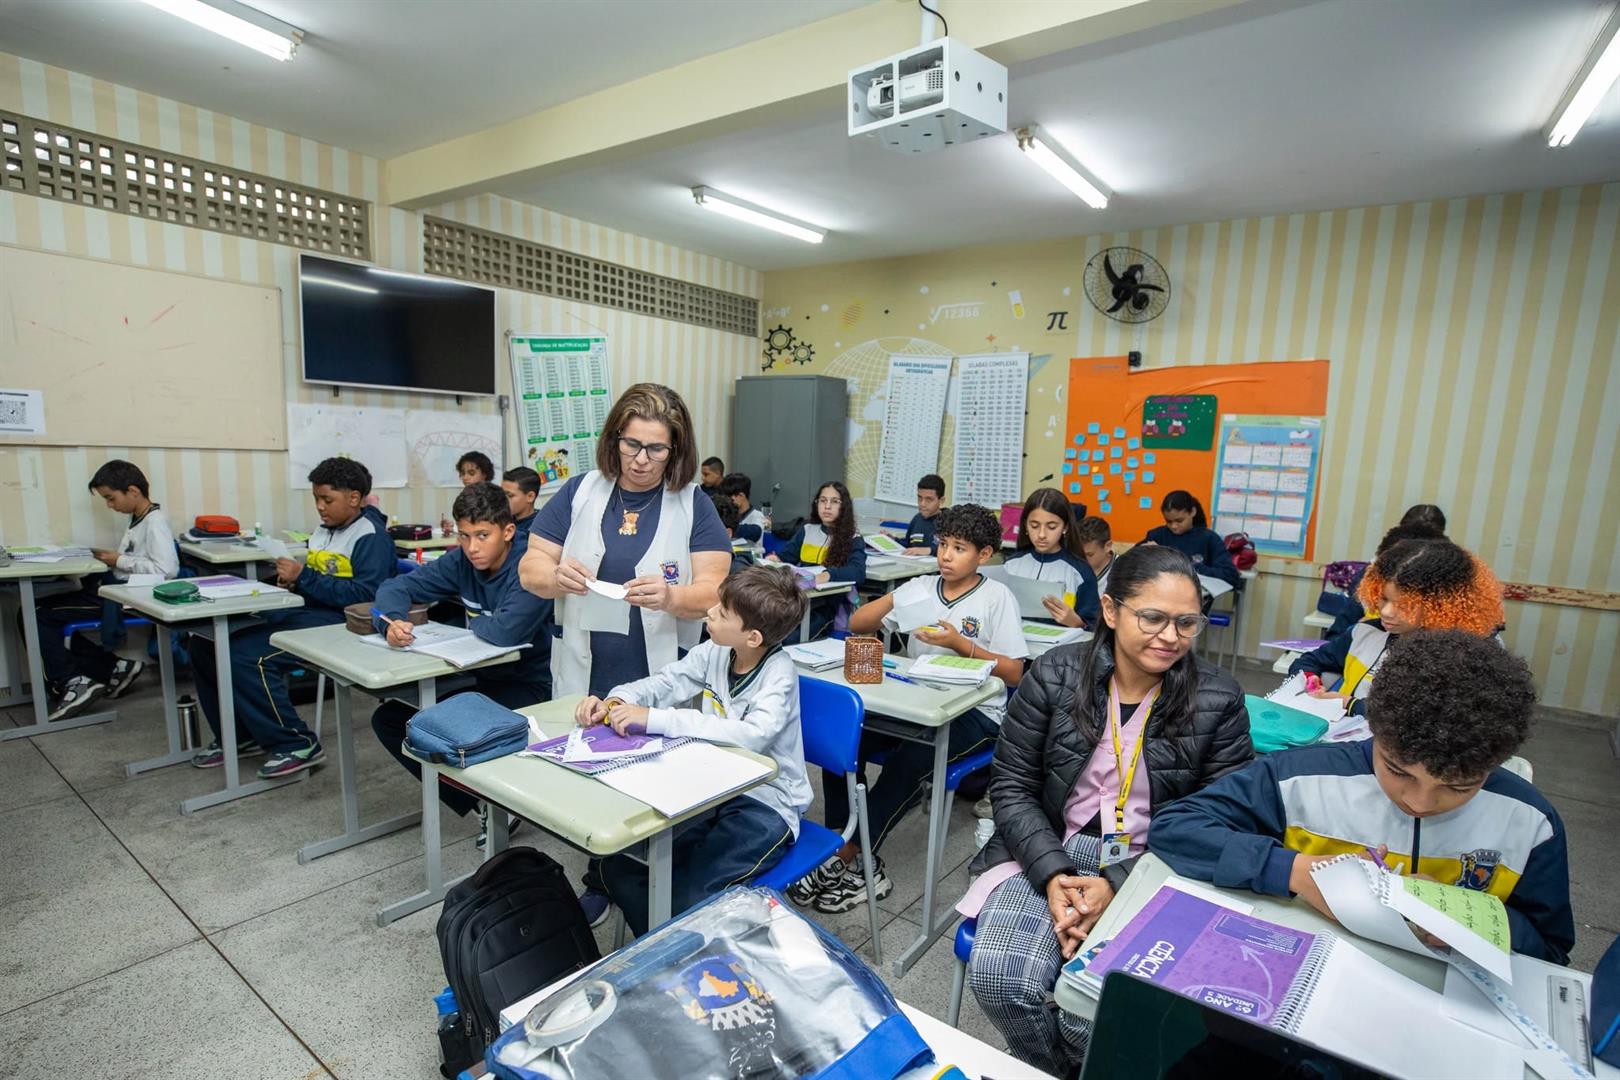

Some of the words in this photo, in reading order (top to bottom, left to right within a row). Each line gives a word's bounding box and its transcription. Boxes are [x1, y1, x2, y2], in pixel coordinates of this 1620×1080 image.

[1204, 995, 1233, 1008] ANO
[1216, 993, 1254, 1008] UNIDADE
[1235, 1004, 1252, 1013] 6º
